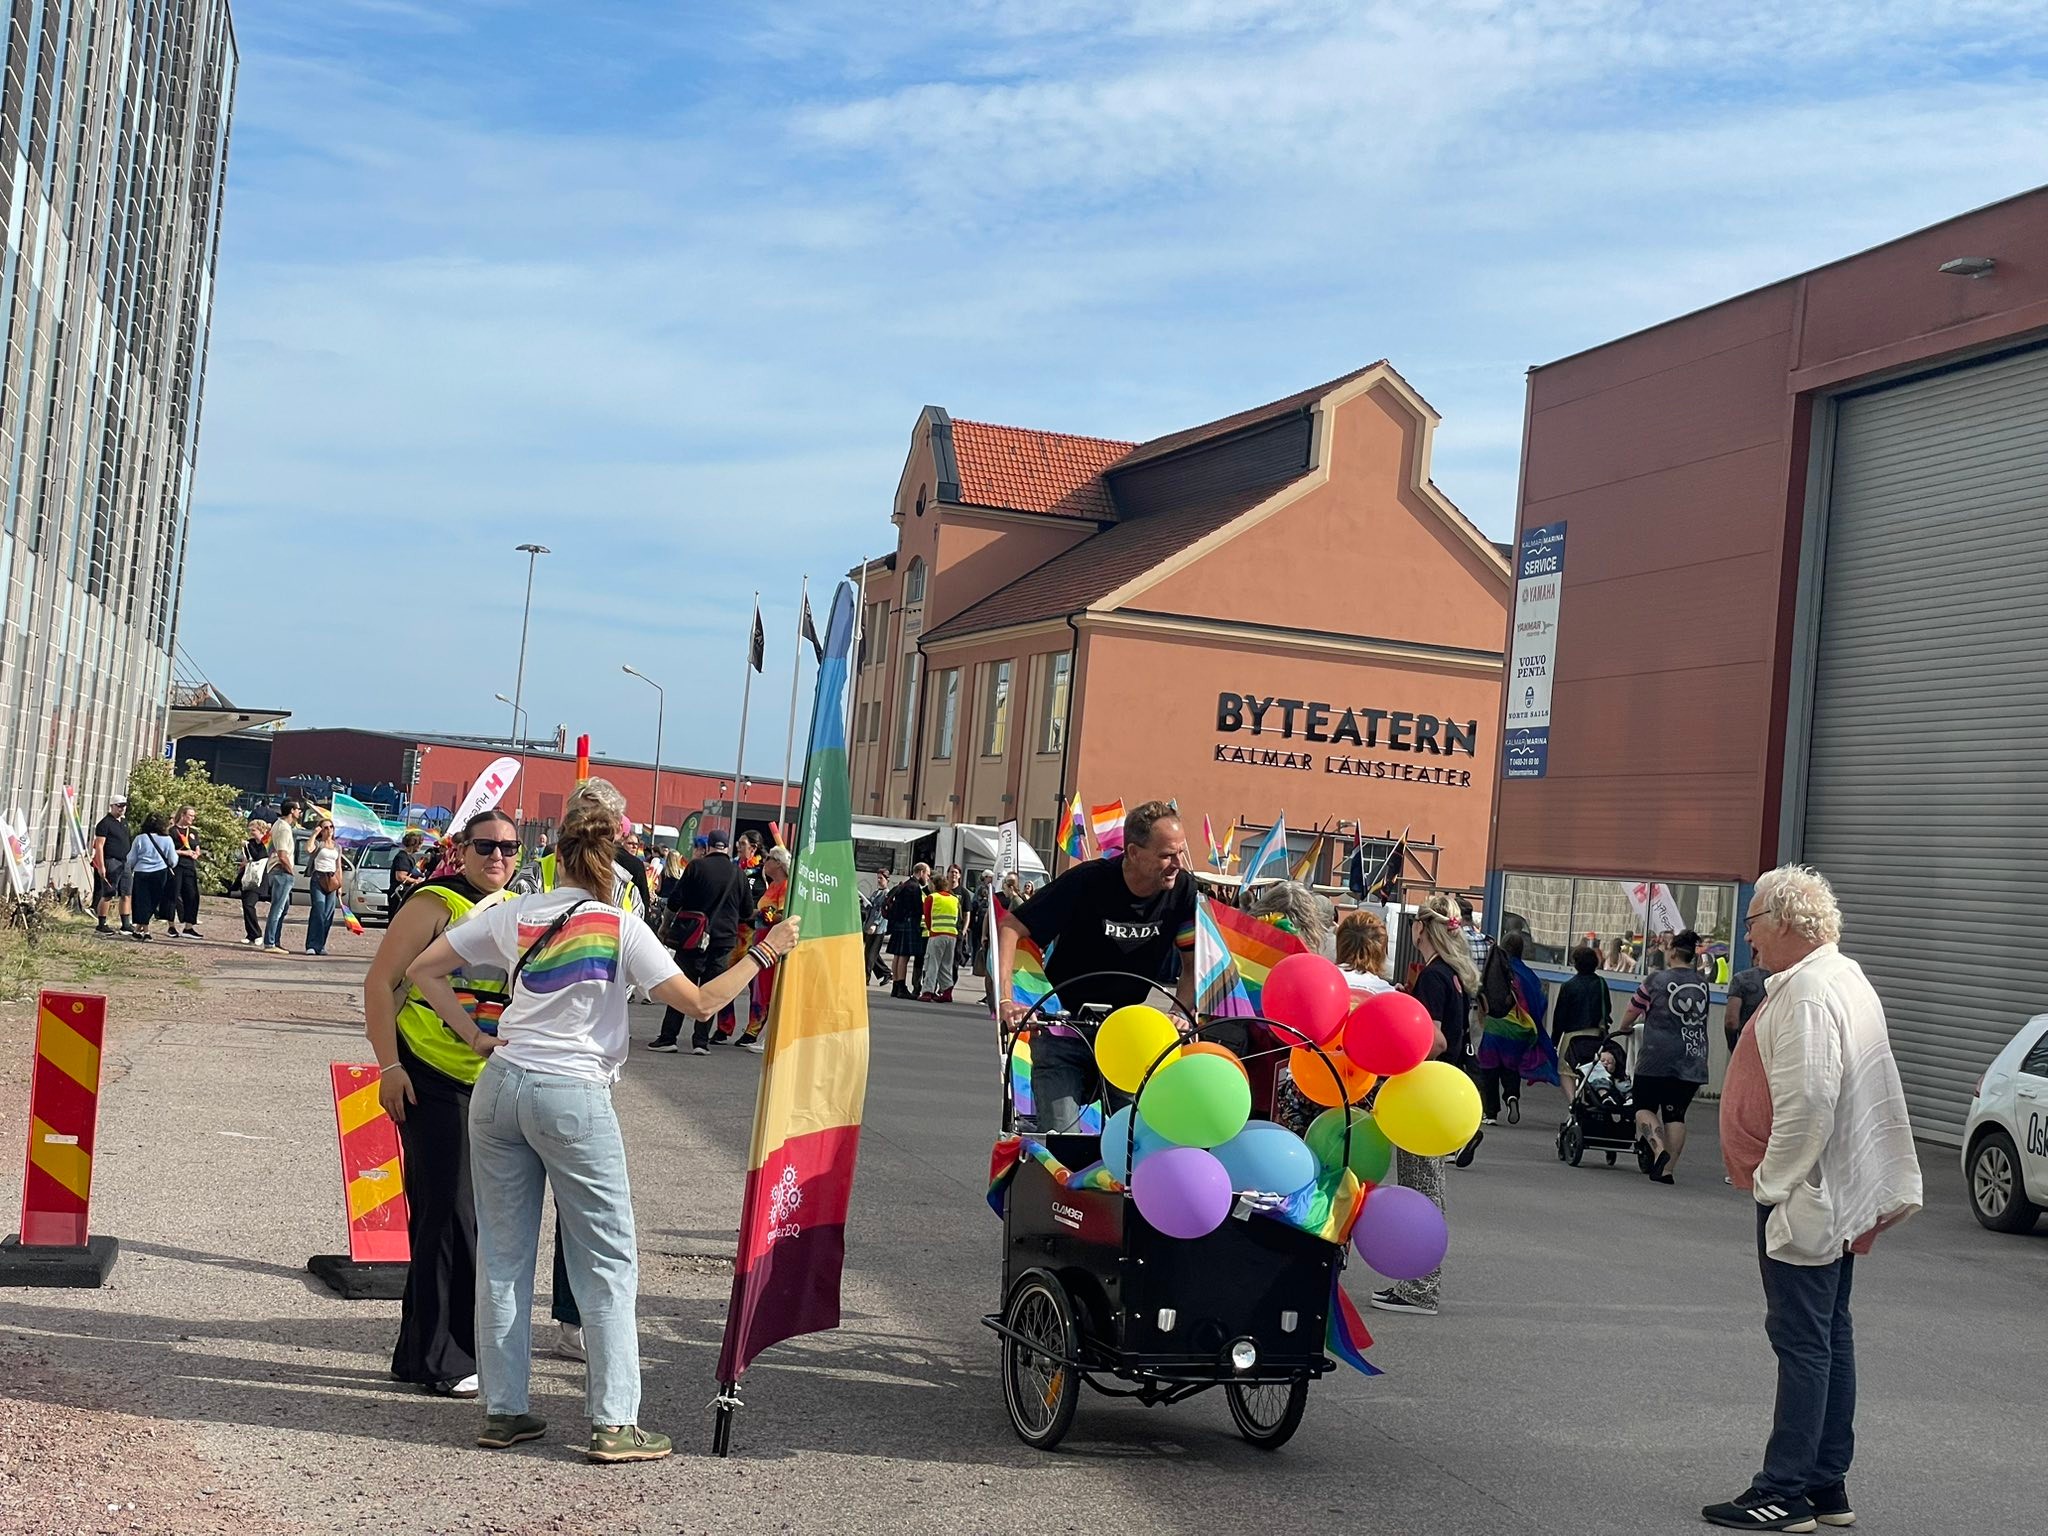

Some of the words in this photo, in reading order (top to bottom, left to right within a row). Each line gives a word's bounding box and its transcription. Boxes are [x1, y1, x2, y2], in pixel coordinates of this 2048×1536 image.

[1543, 533, 1564, 544] MARINA
[1524, 555, 1558, 576] SERVICE
[1529, 582, 1556, 603] YAMAHA
[1519, 654, 1547, 668] VOLVO
[1517, 665, 1546, 679] PENTA
[1508, 711, 1529, 720] NORTH
[1529, 709, 1550, 718] SAILS
[1216, 691, 1478, 758] BYTEATERN
[1526, 737, 1548, 745] MARINA
[1214, 743, 1313, 770] KALMAR
[1325, 755, 1472, 788] LÄNSTEATER
[812, 886, 831, 905] län
[1104, 923, 1161, 939] PRADA
[1051, 1201, 1084, 1222] CLAMBER
